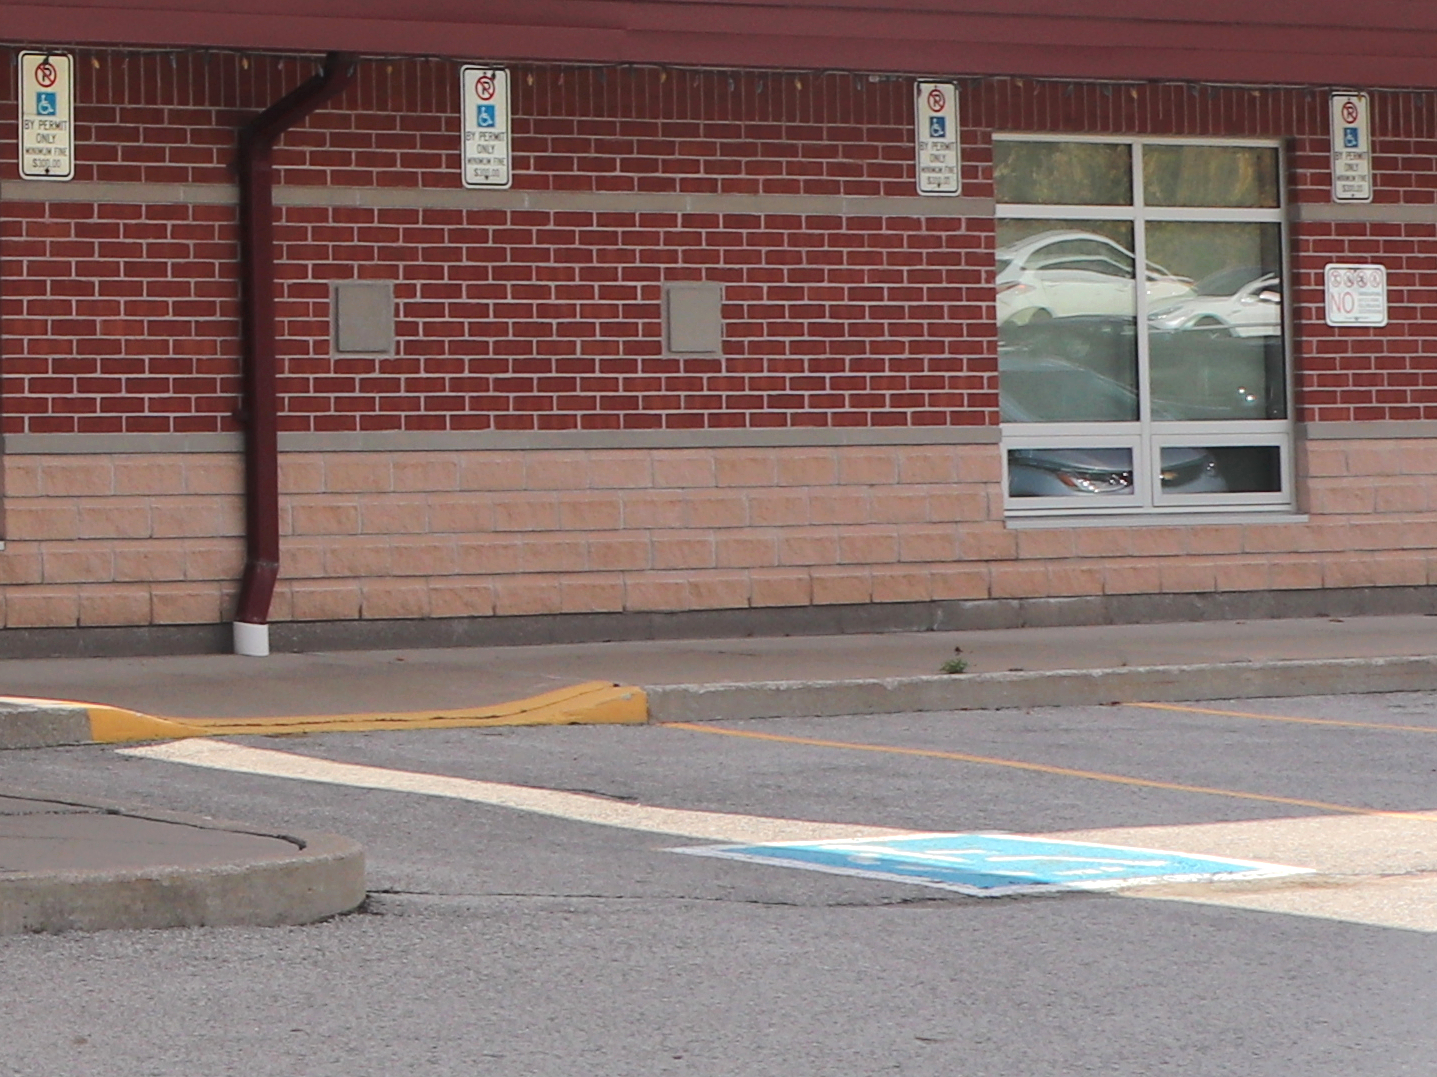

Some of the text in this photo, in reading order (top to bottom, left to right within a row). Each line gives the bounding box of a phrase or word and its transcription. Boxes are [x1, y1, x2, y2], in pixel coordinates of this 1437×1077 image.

[24, 119, 67, 131] BY PERMIT
[36, 133, 56, 144] ONLY
[466, 131, 506, 142] BY PERMIT
[54, 147, 68, 157] FINE
[477, 143, 495, 154] ONLY
[1330, 291, 1355, 314] NO
